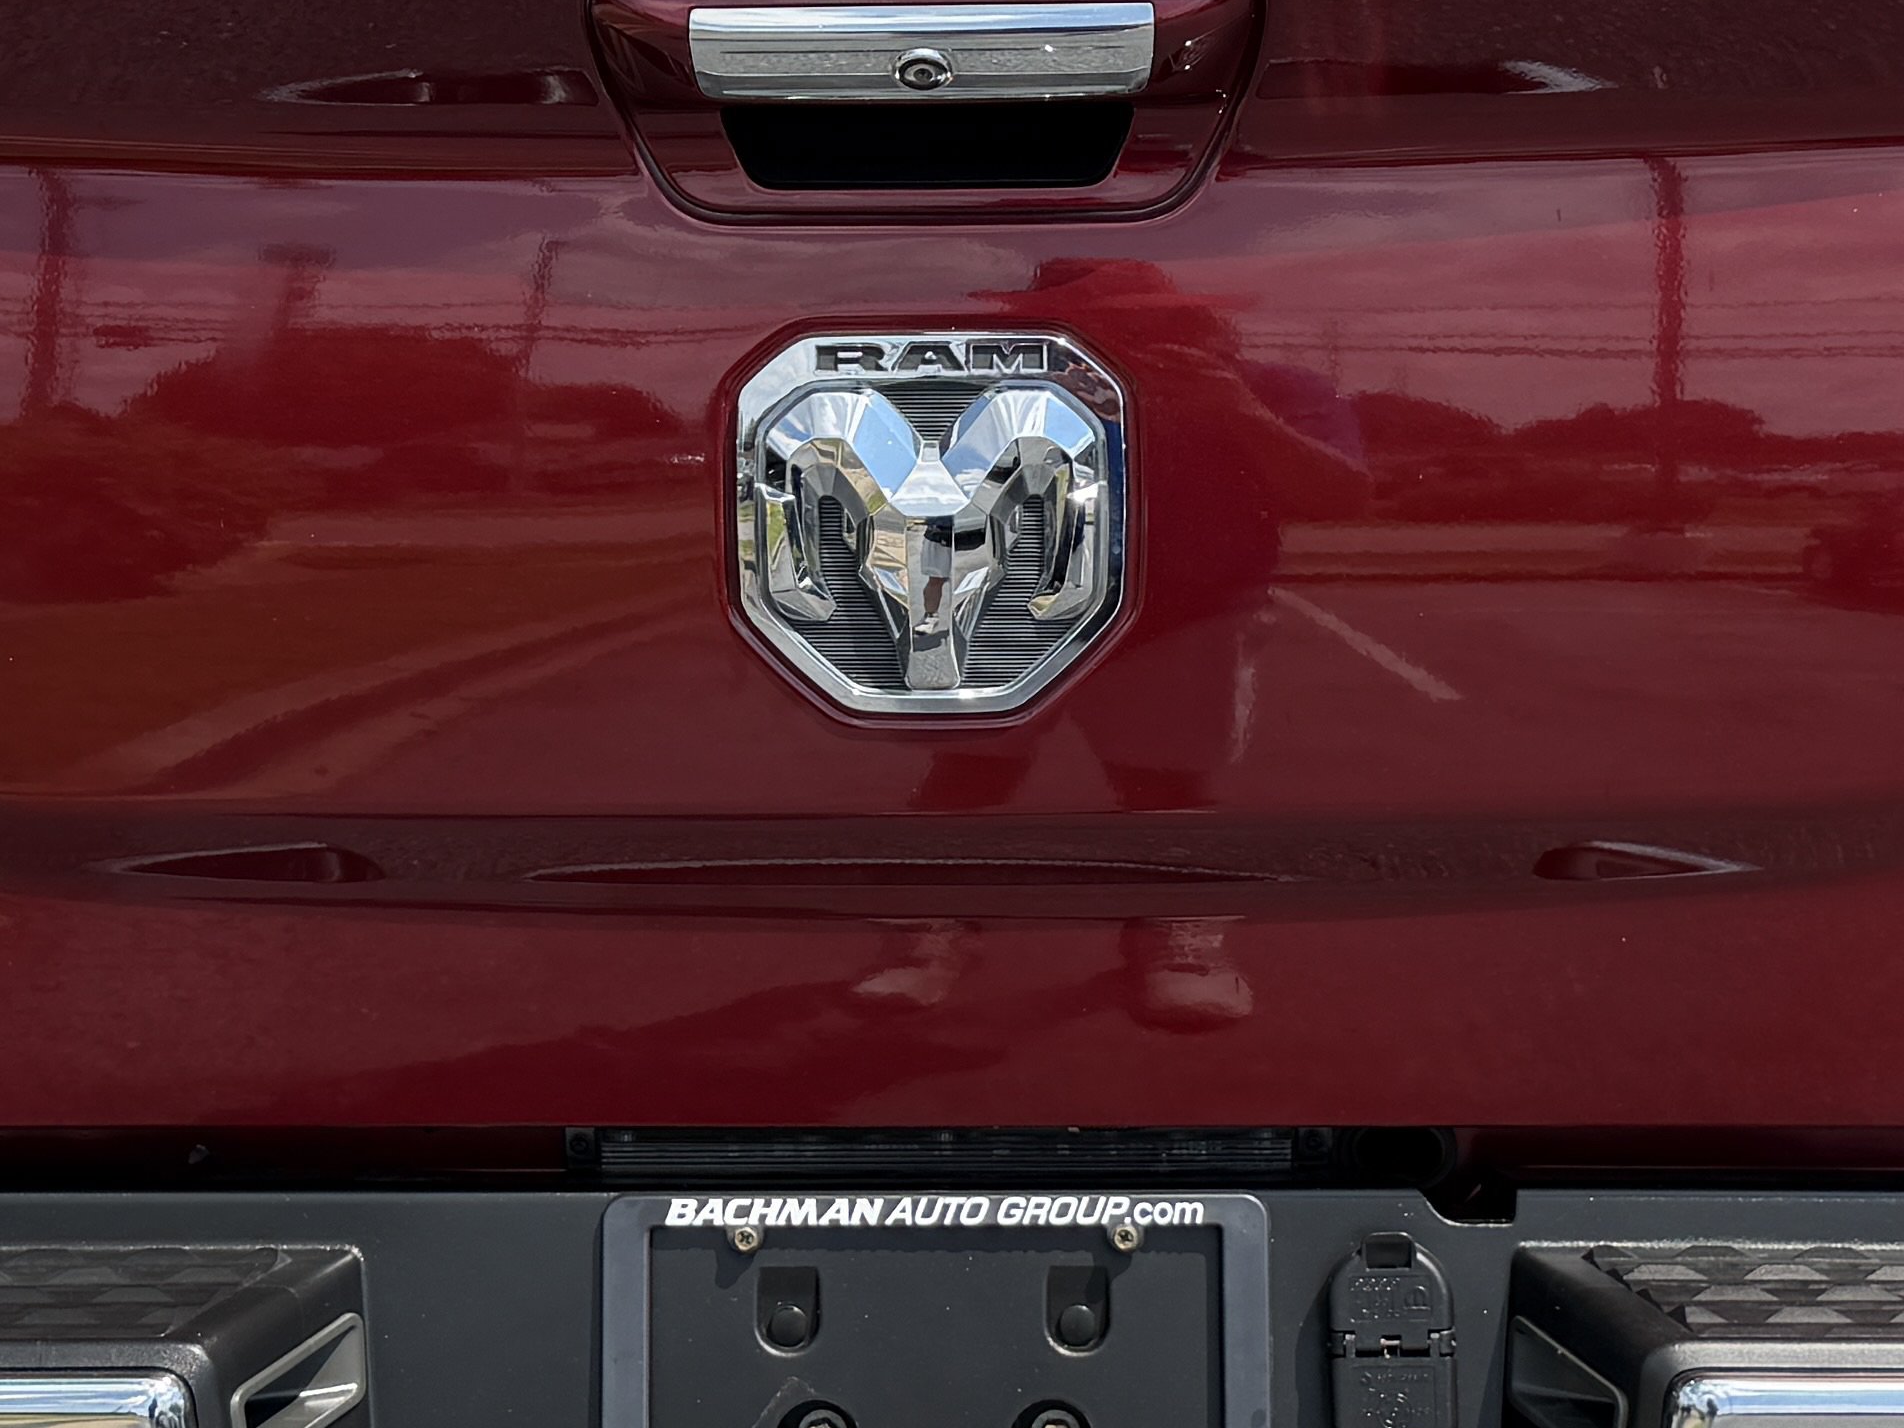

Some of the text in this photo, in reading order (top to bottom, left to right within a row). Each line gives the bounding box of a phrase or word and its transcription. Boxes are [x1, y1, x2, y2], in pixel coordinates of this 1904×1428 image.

[813, 340, 1049, 374] RAM
[664, 1196, 1205, 1227] BACHMAN AUTO GROUP.com
